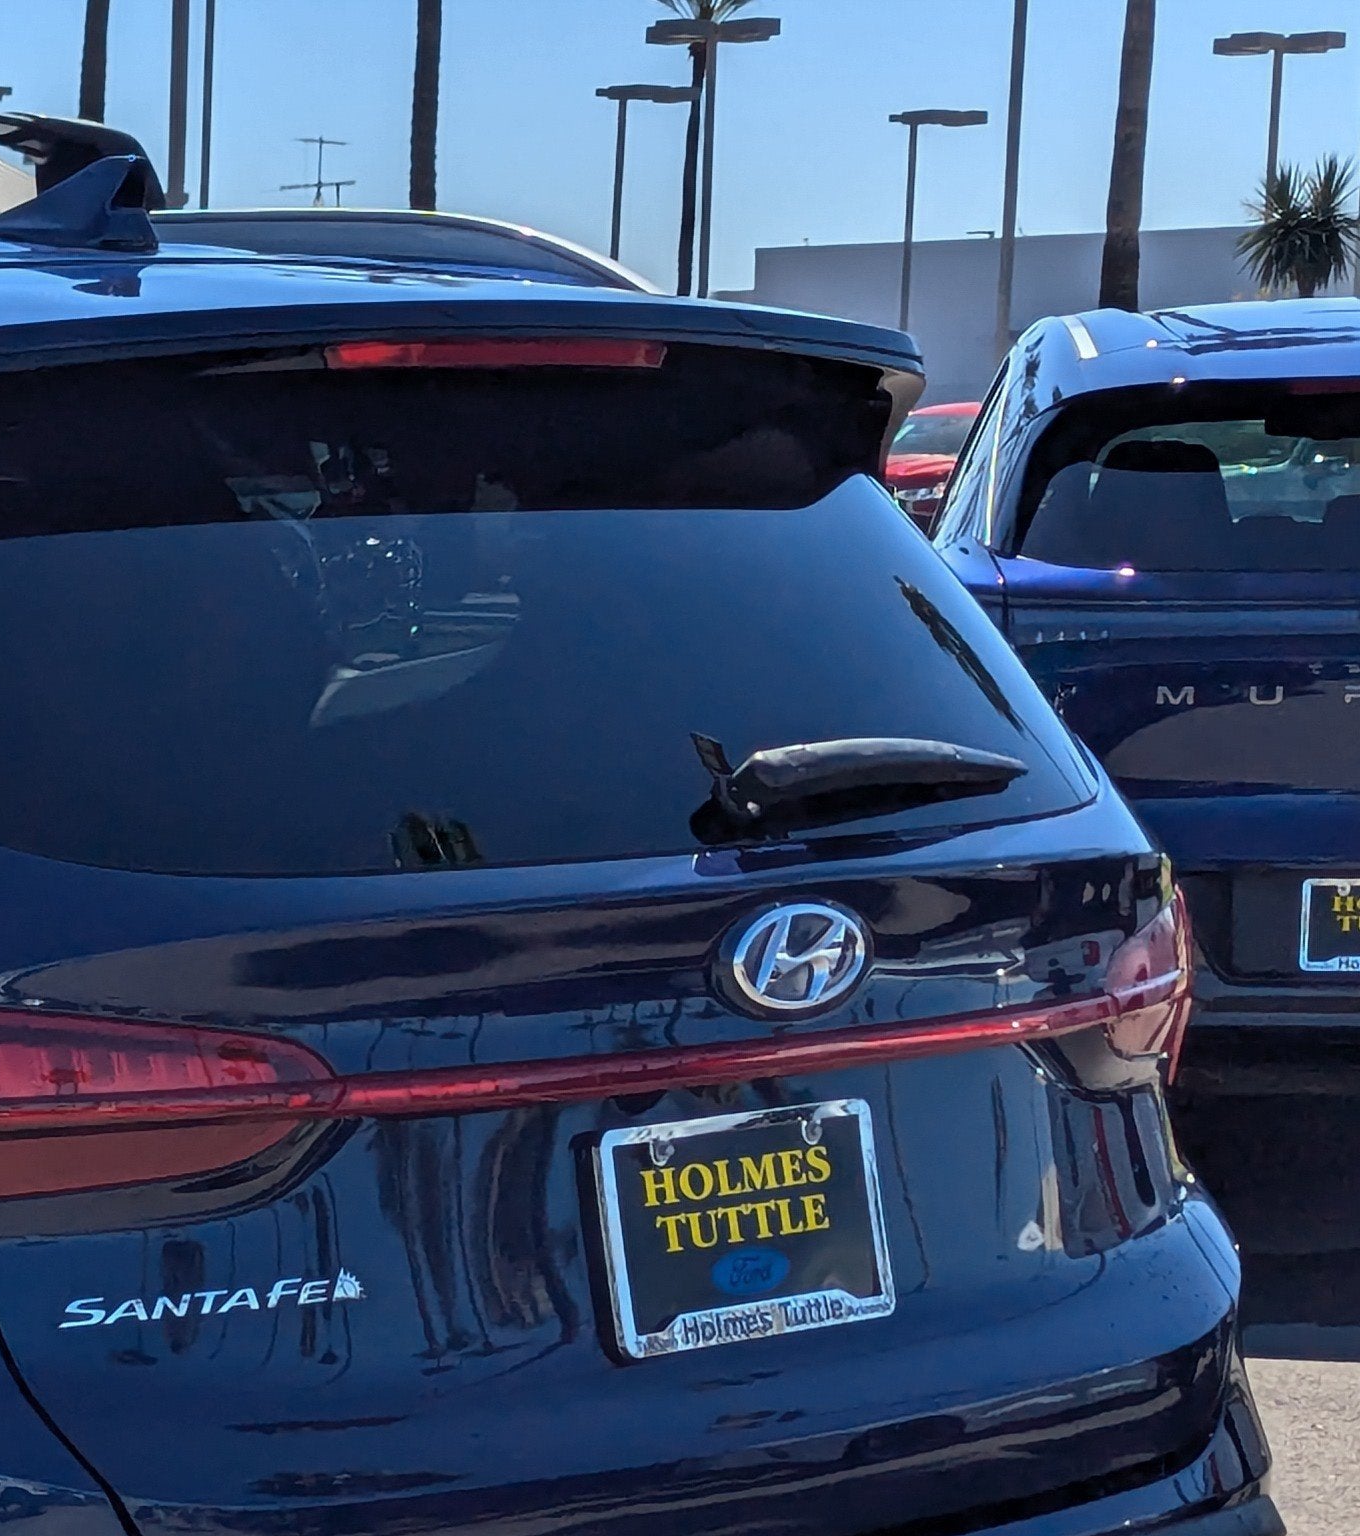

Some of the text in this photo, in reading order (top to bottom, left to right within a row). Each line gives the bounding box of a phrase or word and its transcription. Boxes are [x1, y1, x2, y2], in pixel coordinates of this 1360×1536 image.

[1331, 896, 1360, 912] H
[639, 1145, 831, 1207] HOLMES
[655, 1193, 830, 1253] TUTTLE
[681, 1308, 775, 1346] Holmes
[778, 1295, 844, 1327] Tuttle
